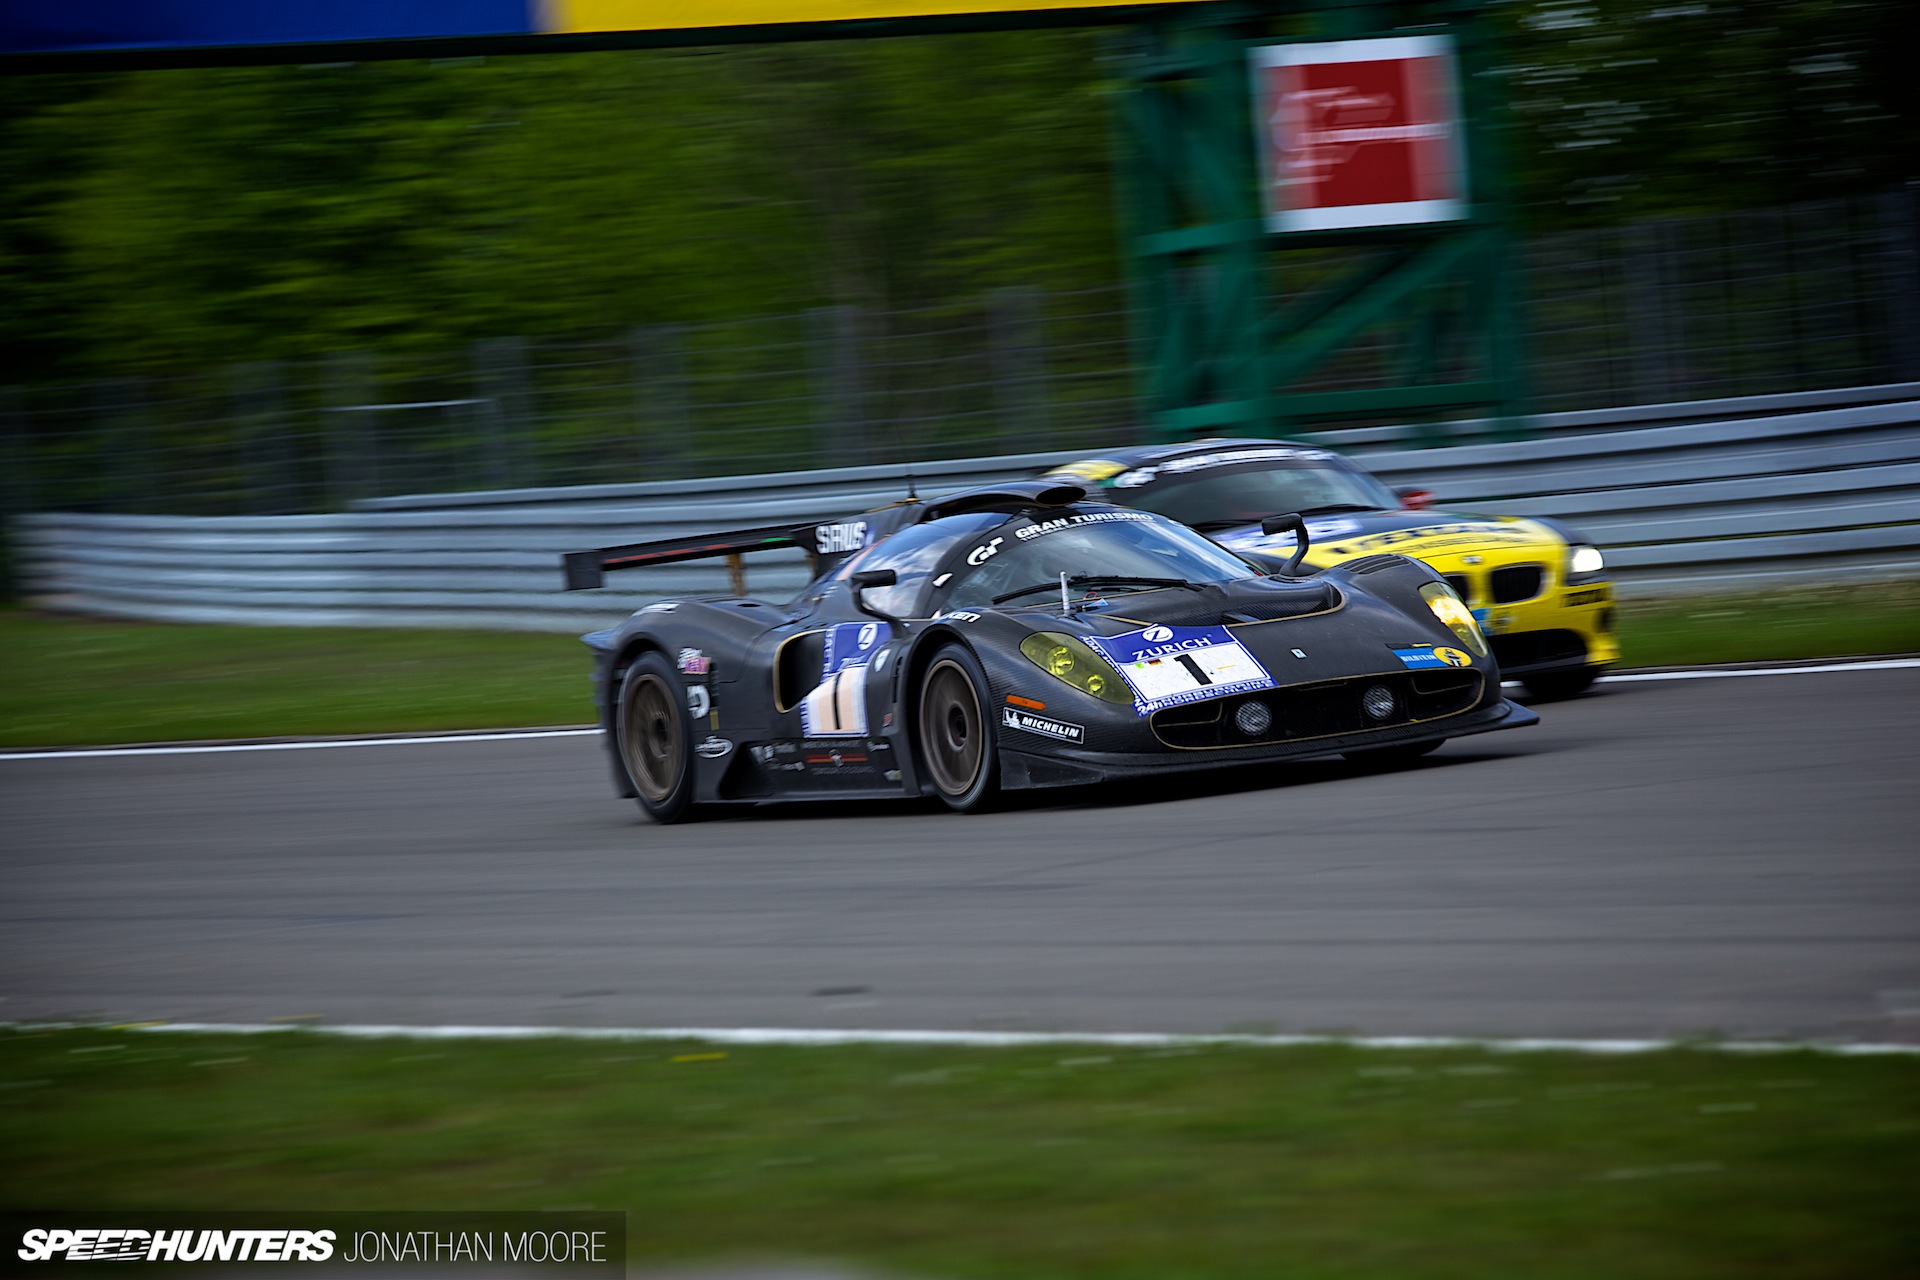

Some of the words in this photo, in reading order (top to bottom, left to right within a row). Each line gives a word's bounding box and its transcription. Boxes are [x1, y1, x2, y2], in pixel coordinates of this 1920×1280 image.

[1015, 518, 1068, 539] GRAN
[1069, 512, 1155, 524] TURISMO
[1131, 637, 1212, 661] ZURICH
[1400, 654, 1437, 663] BILSTEIN
[1174, 653, 1213, 686] 1
[832, 671, 843, 730] 1
[1021, 716, 1079, 738] MICHELIN
